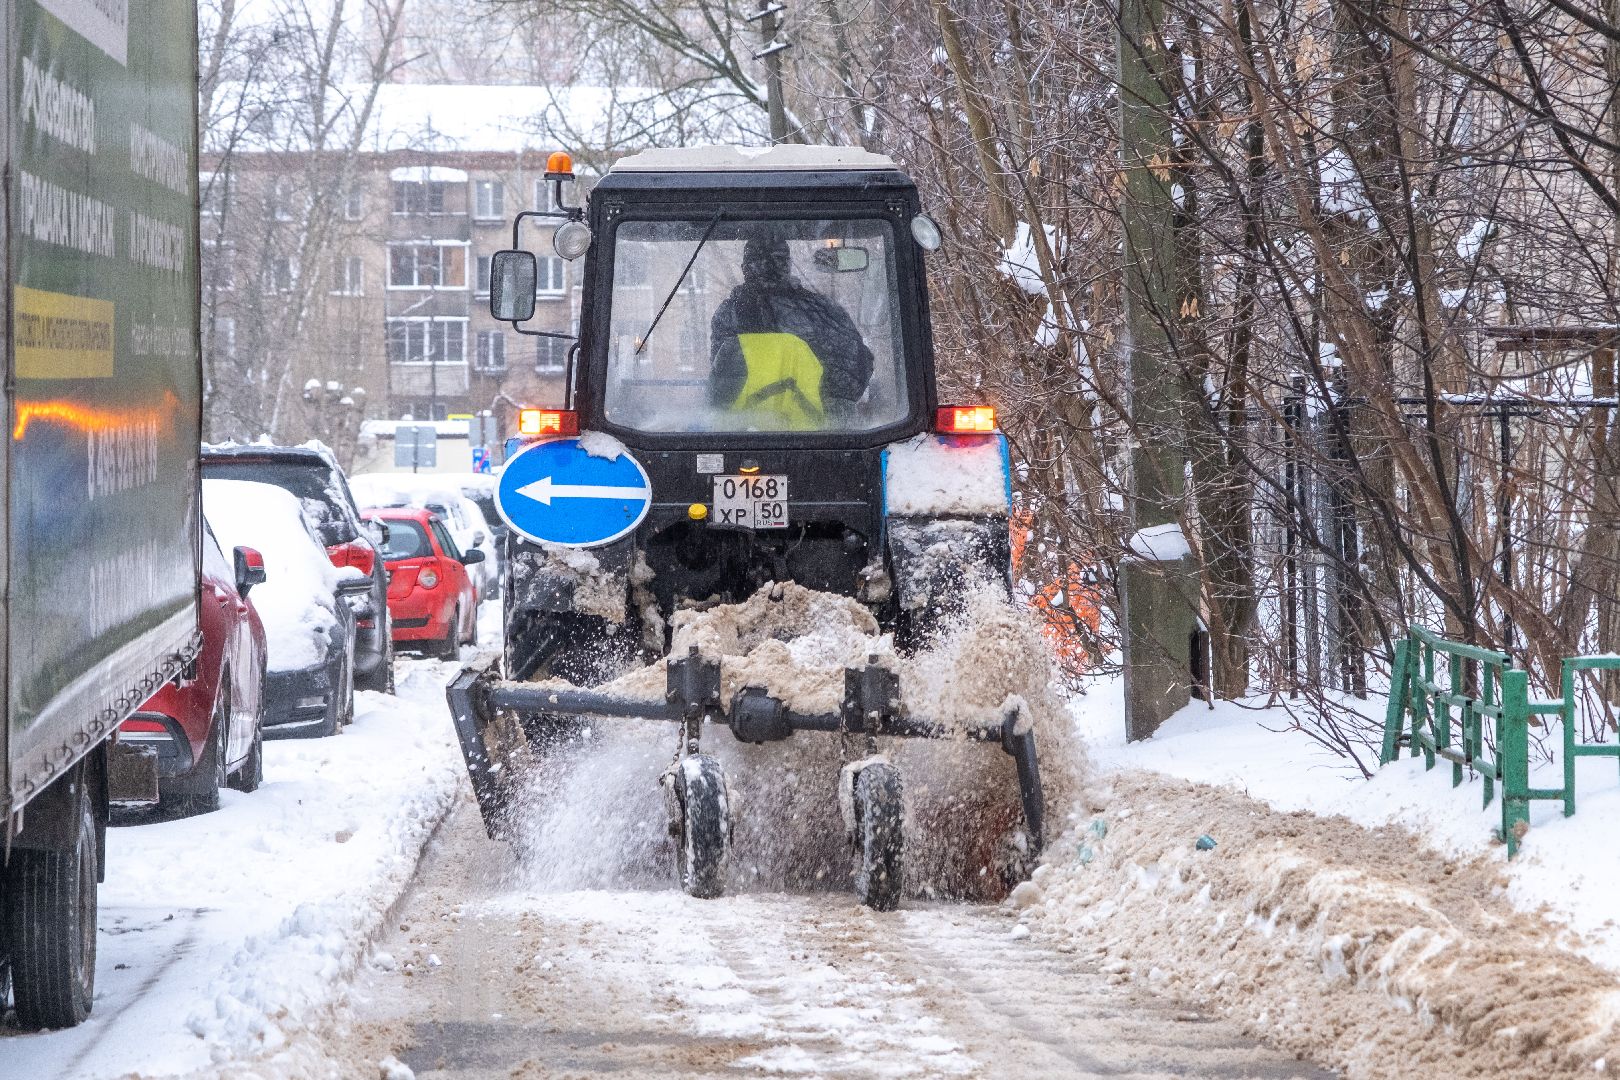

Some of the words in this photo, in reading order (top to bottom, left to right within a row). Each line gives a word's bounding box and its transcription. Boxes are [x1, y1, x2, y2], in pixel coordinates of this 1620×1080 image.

[20, 170, 67, 246] ПРОДАЖА
[69, 190, 76, 248] И
[78, 193, 114, 258] МОНТАЖ
[723, 478, 778, 499] 0168
[761, 503, 782, 519] 50
